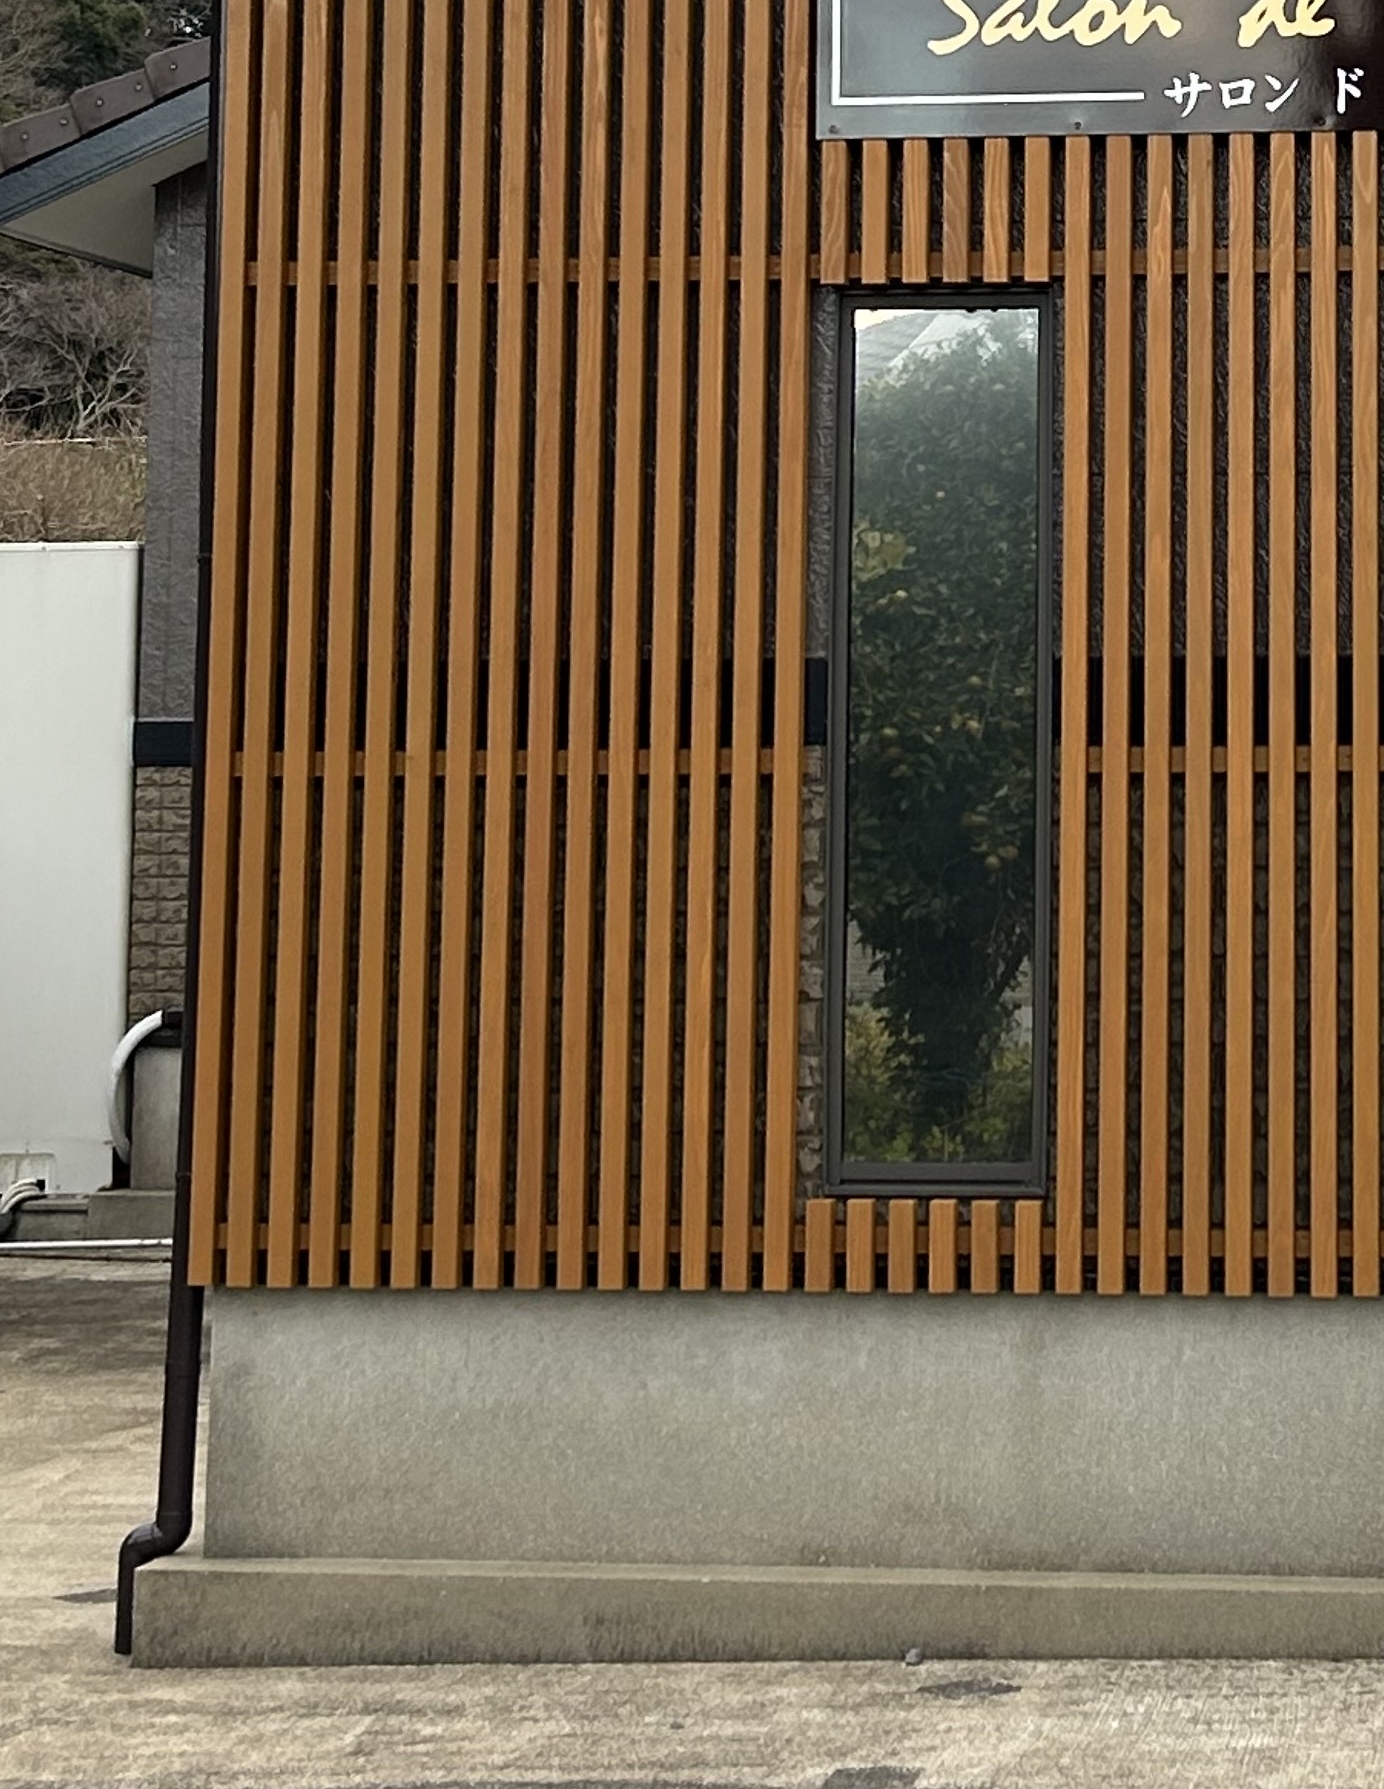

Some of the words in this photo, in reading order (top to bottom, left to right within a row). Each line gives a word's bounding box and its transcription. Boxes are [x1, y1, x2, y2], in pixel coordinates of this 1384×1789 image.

[1163, 72, 1302, 120] サロン
[1332, 66, 1366, 115] ド
